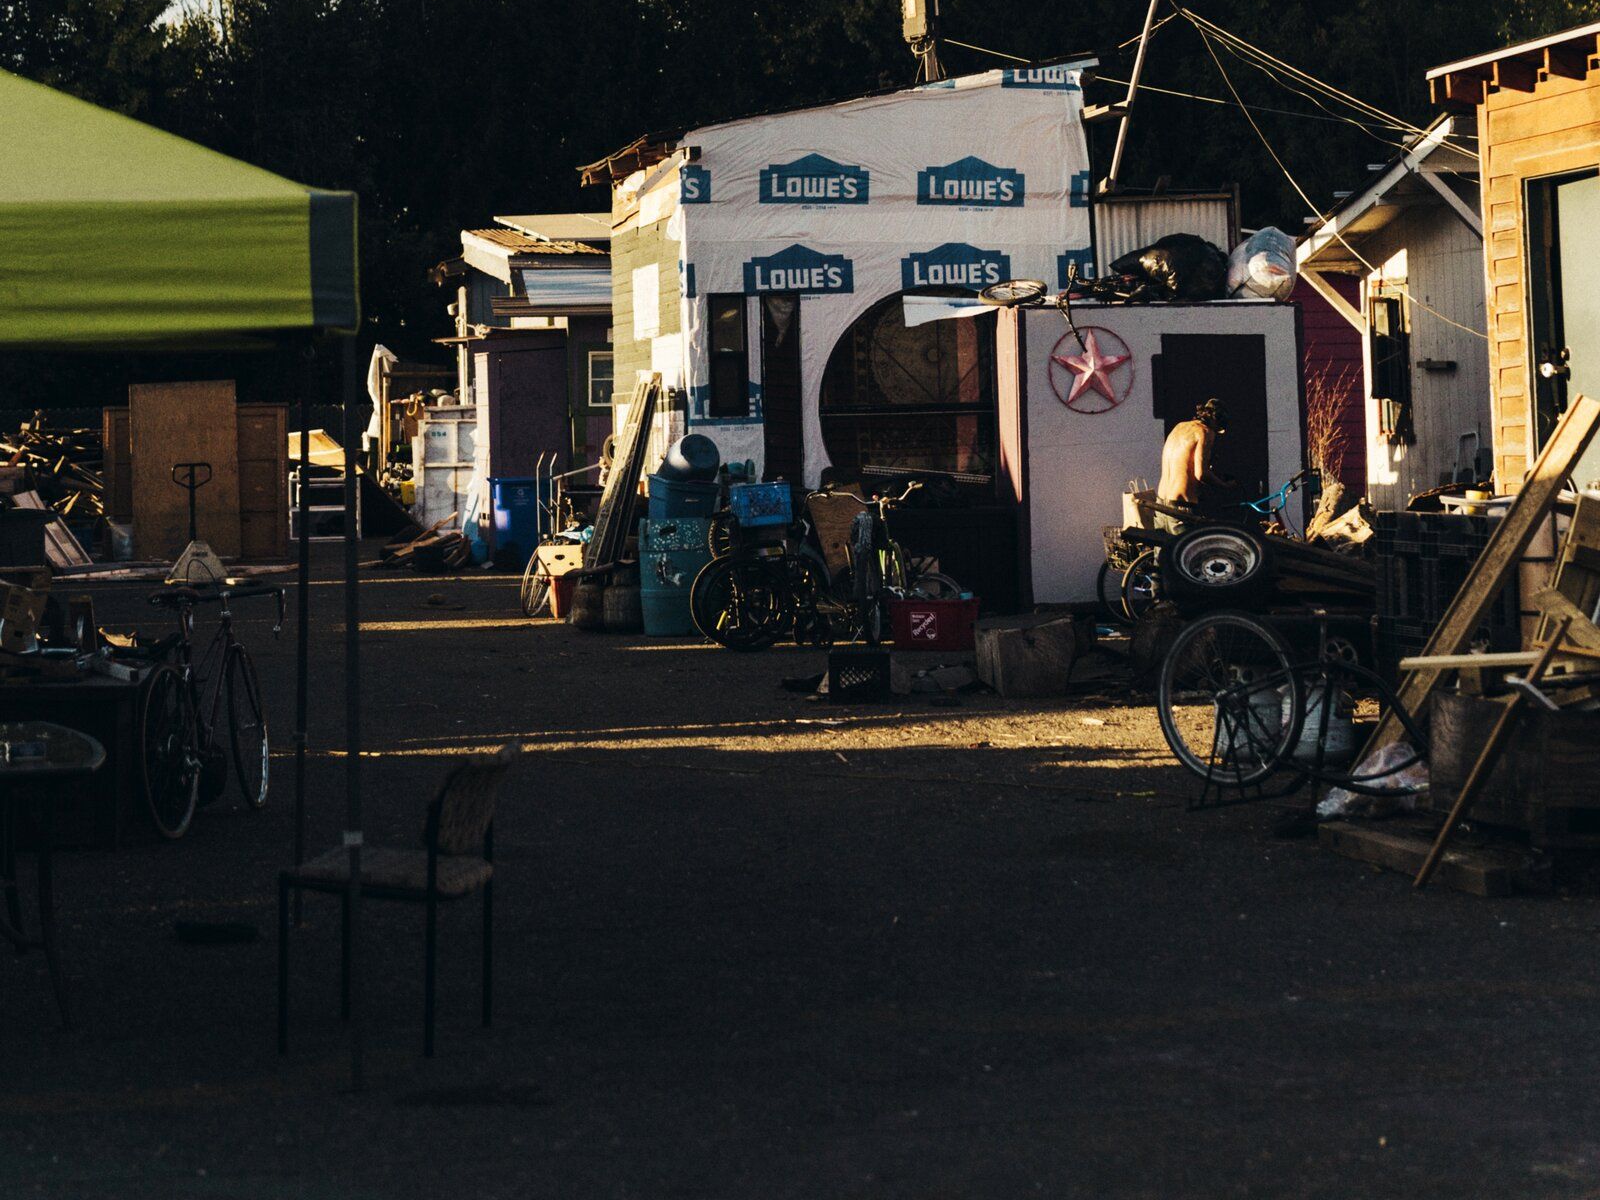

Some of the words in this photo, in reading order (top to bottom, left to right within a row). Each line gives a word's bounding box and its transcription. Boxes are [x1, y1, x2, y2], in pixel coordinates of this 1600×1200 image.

[771, 174, 858, 199] LOWE'S
[929, 175, 1014, 201] LOWE'S
[755, 264, 843, 289] LOWE'S
[913, 259, 1000, 285] LOWE'S
